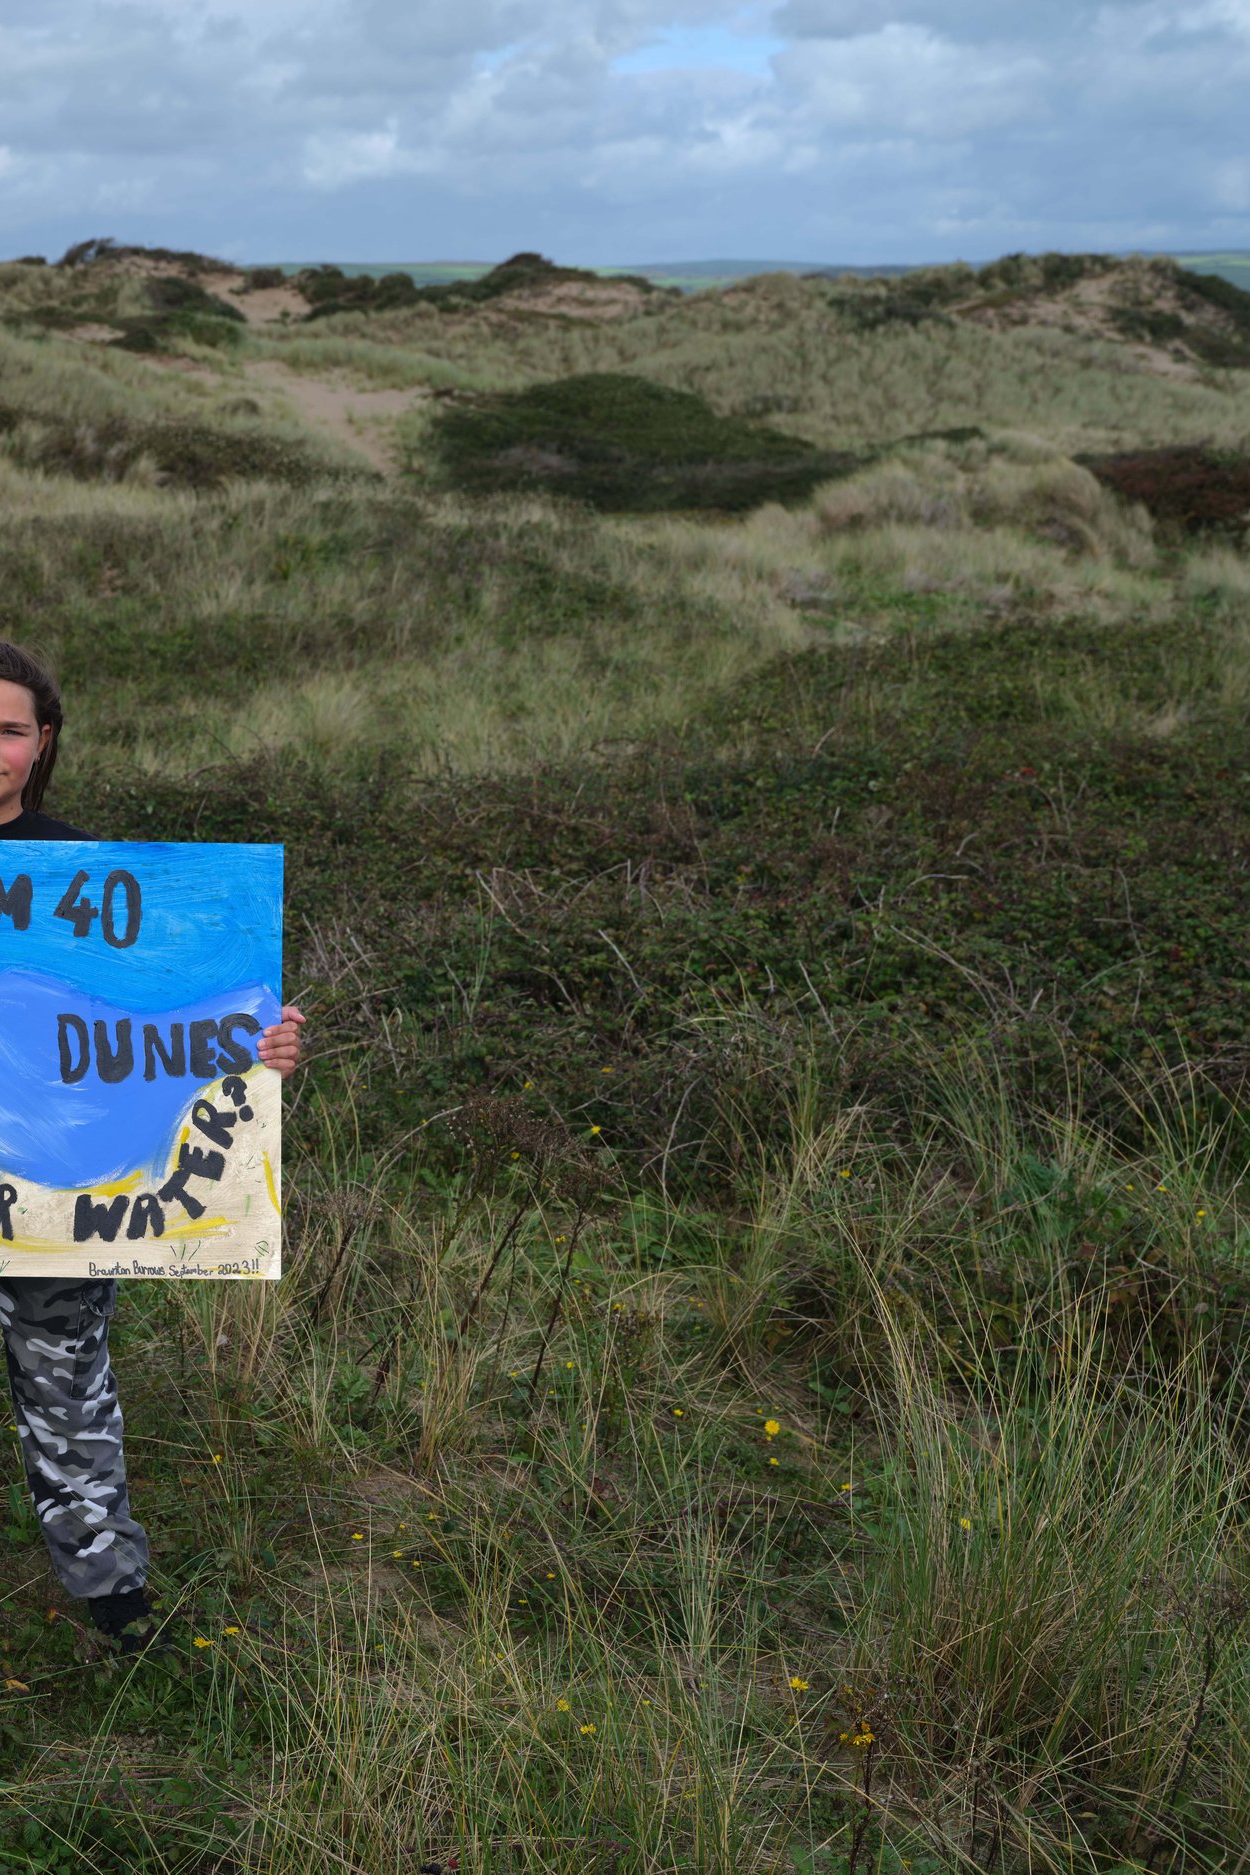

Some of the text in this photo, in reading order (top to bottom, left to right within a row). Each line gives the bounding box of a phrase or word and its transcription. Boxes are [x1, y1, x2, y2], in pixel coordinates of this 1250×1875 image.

[53, 869, 142, 948] 40
[57, 1013, 264, 1083] DUNES
[73, 1075, 254, 1243] WATER?
[217, 1258, 260, 1275] 2023!!
